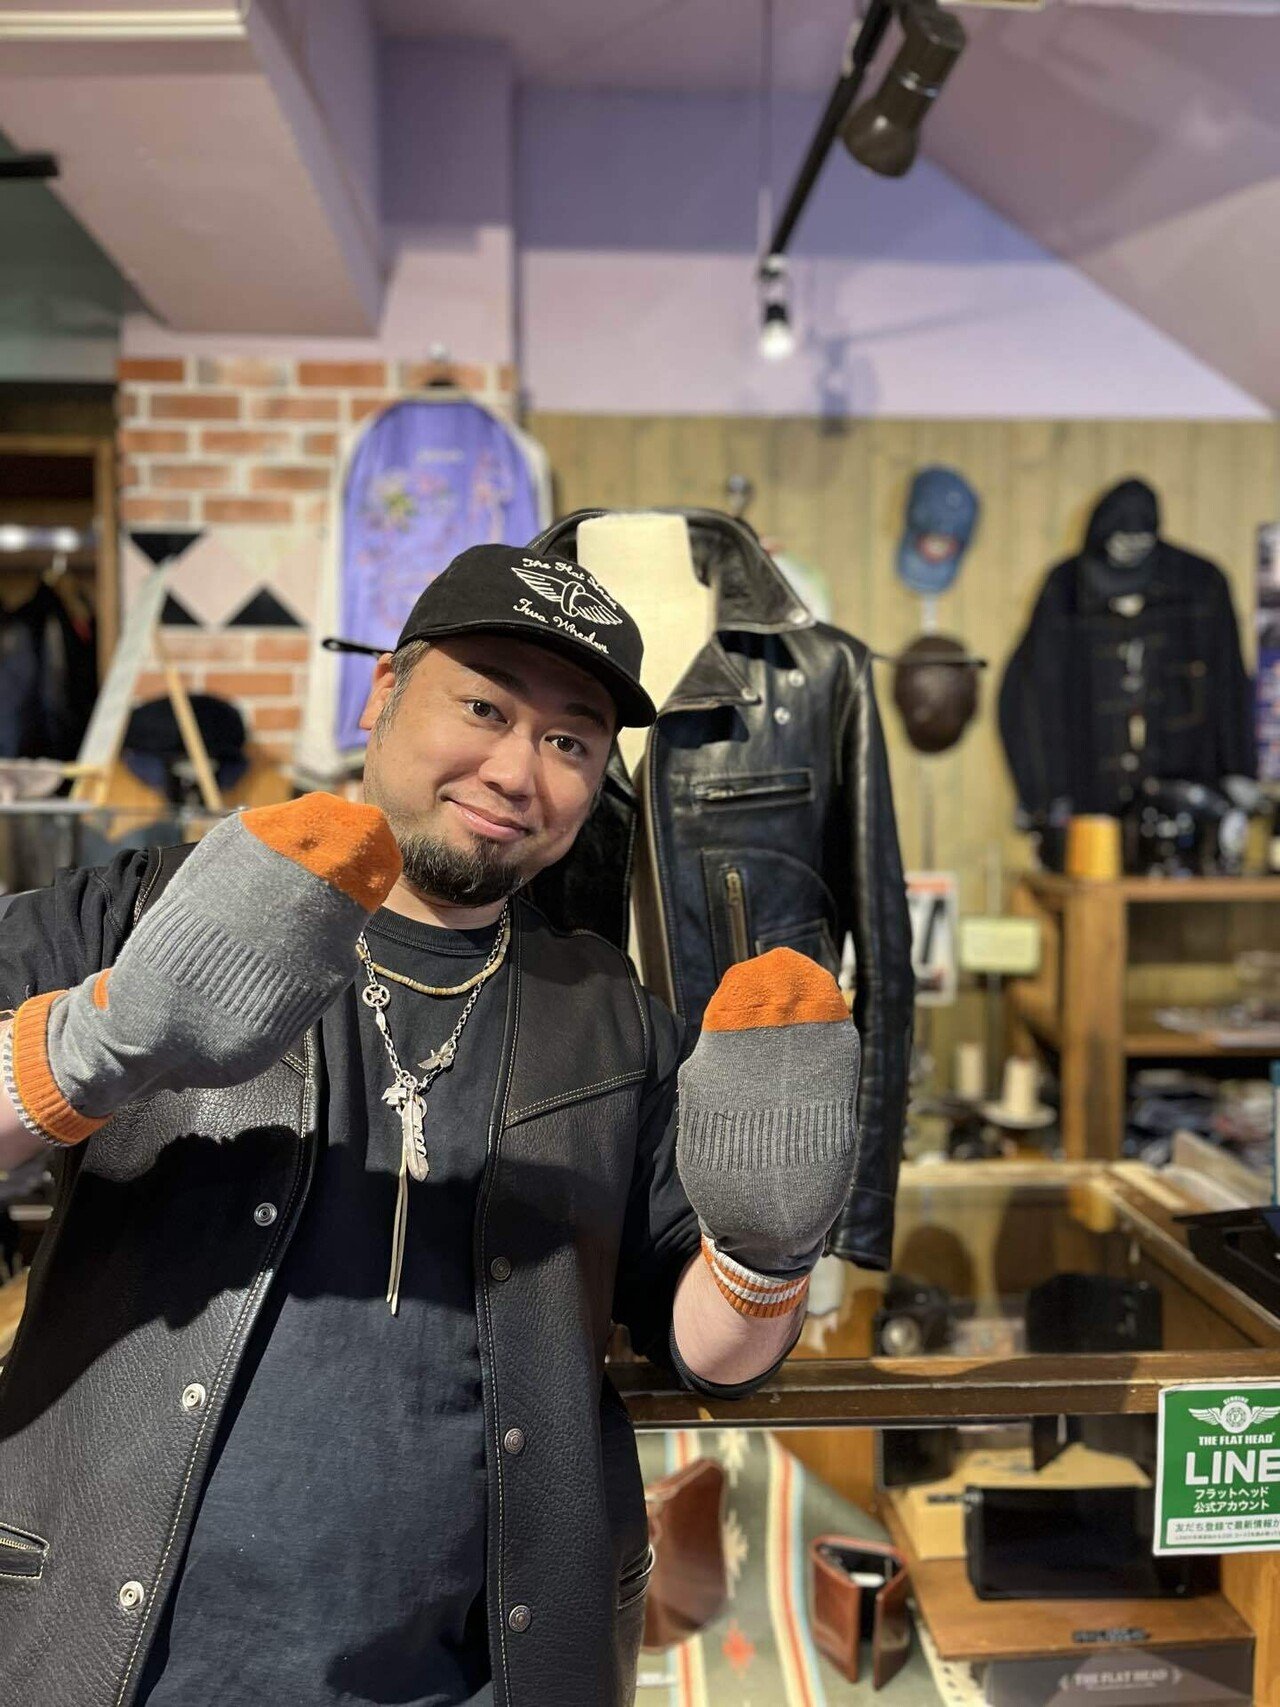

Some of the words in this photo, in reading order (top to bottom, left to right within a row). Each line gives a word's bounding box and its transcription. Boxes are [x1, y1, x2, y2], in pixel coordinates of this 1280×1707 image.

[522, 558, 551, 569] The
[554, 561, 585, 580] Flat
[513, 598, 549, 623] Two
[1199, 1436, 1217, 1446] THE
[1219, 1435, 1243, 1445] FLAT
[1245, 1434, 1273, 1444] HEAD
[1185, 1449, 1280, 1485] LINE
[1195, 1486, 1269, 1500] フラットヘッド
[1194, 1499, 1269, 1513] 公式アカウント
